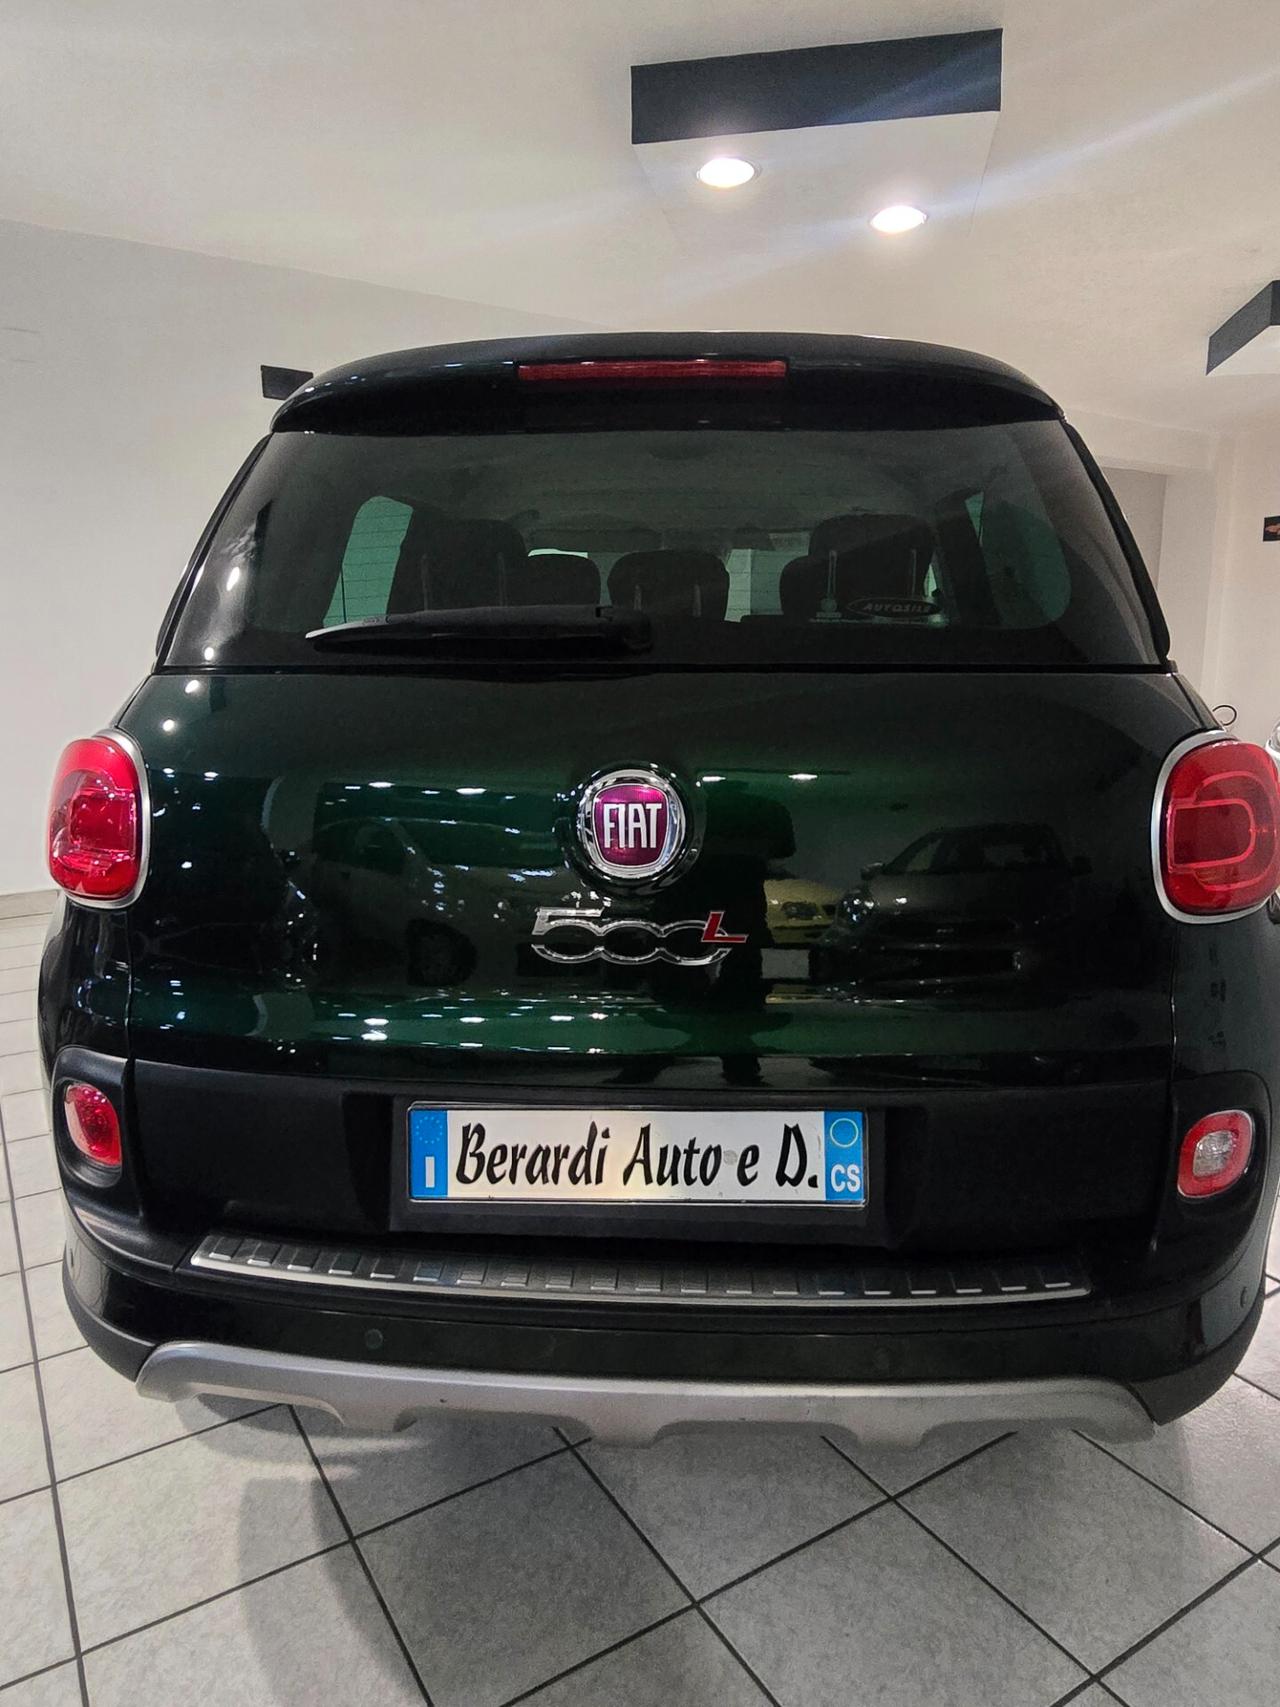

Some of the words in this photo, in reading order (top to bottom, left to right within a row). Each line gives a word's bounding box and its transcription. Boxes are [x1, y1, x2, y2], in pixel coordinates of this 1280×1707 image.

[603, 803, 662, 849] FIAT
[455, 1121, 610, 1186] Berardi
[623, 1123, 722, 1187] Auto
[737, 1144, 760, 1187] e
[775, 1123, 819, 1188] D.
[830, 1164, 861, 1193] CS
